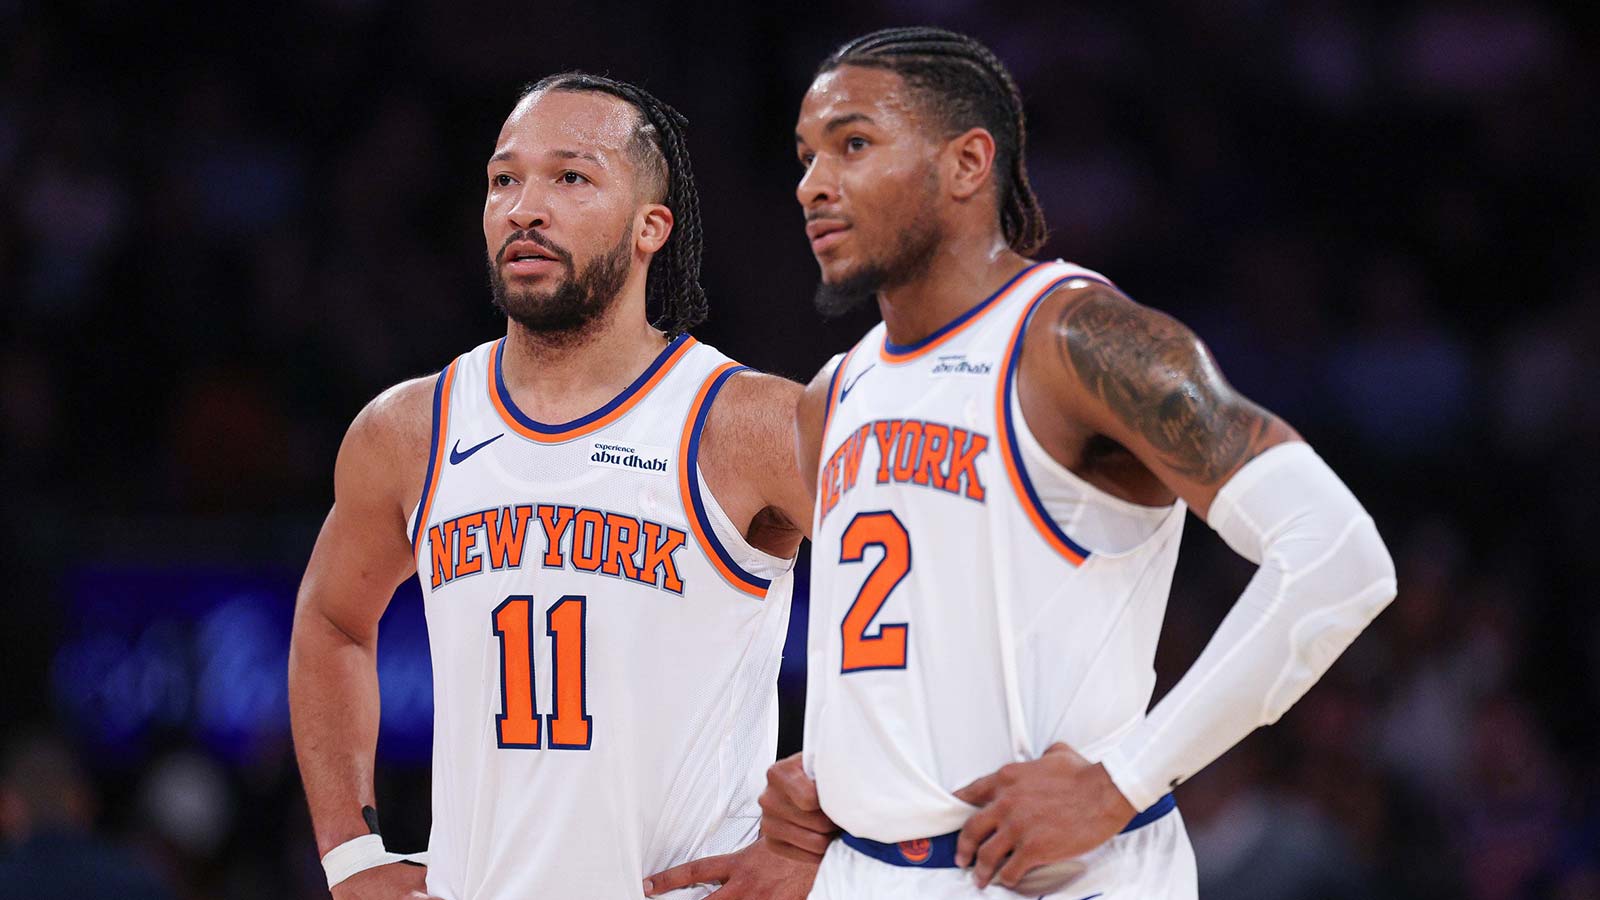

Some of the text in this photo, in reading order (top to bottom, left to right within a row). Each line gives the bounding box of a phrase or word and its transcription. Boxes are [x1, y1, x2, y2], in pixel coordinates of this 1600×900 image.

[591, 451, 668, 471] abu dhabi
[594, 443, 635, 453] experience
[873, 418, 989, 505] YORK
[428, 502, 689, 598] NEW YORK
[839, 510, 912, 675] 2
[491, 595, 593, 750] 11
